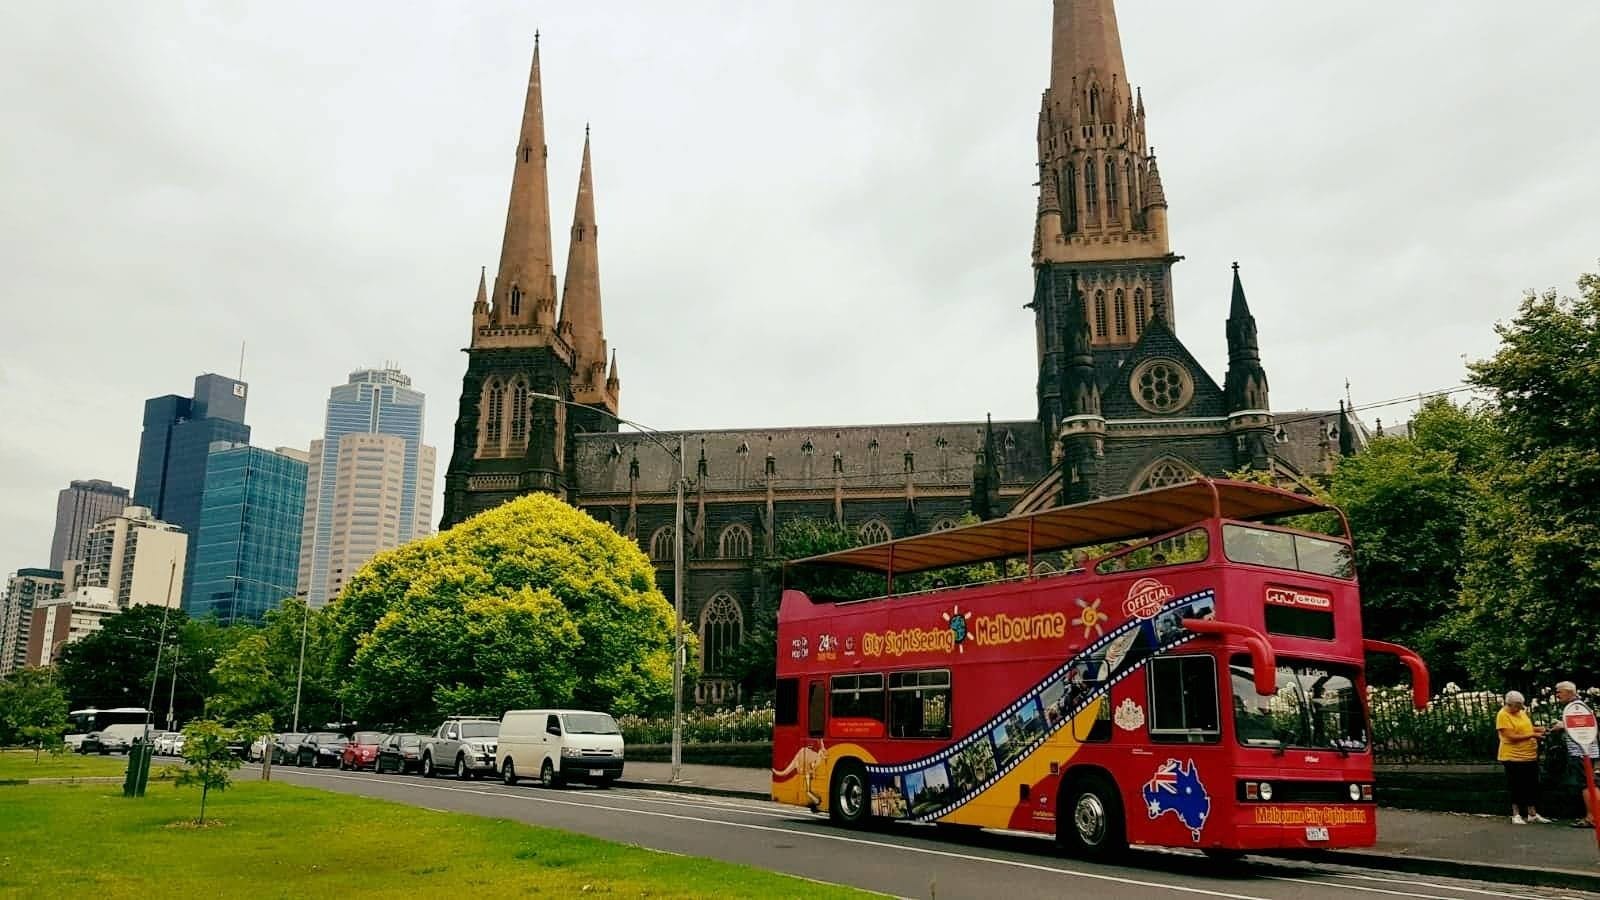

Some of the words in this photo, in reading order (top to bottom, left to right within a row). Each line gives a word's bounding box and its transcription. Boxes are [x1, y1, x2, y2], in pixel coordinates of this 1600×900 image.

[1127, 587, 1171, 612] OFFICIAL
[1298, 595, 1328, 606] GROUP
[863, 632, 884, 656] City
[885, 628, 955, 655] SightSeeing
[975, 612, 1066, 645] Melbourne
[1255, 807, 1304, 824] Melbourne
[1304, 807, 1324, 825] City
